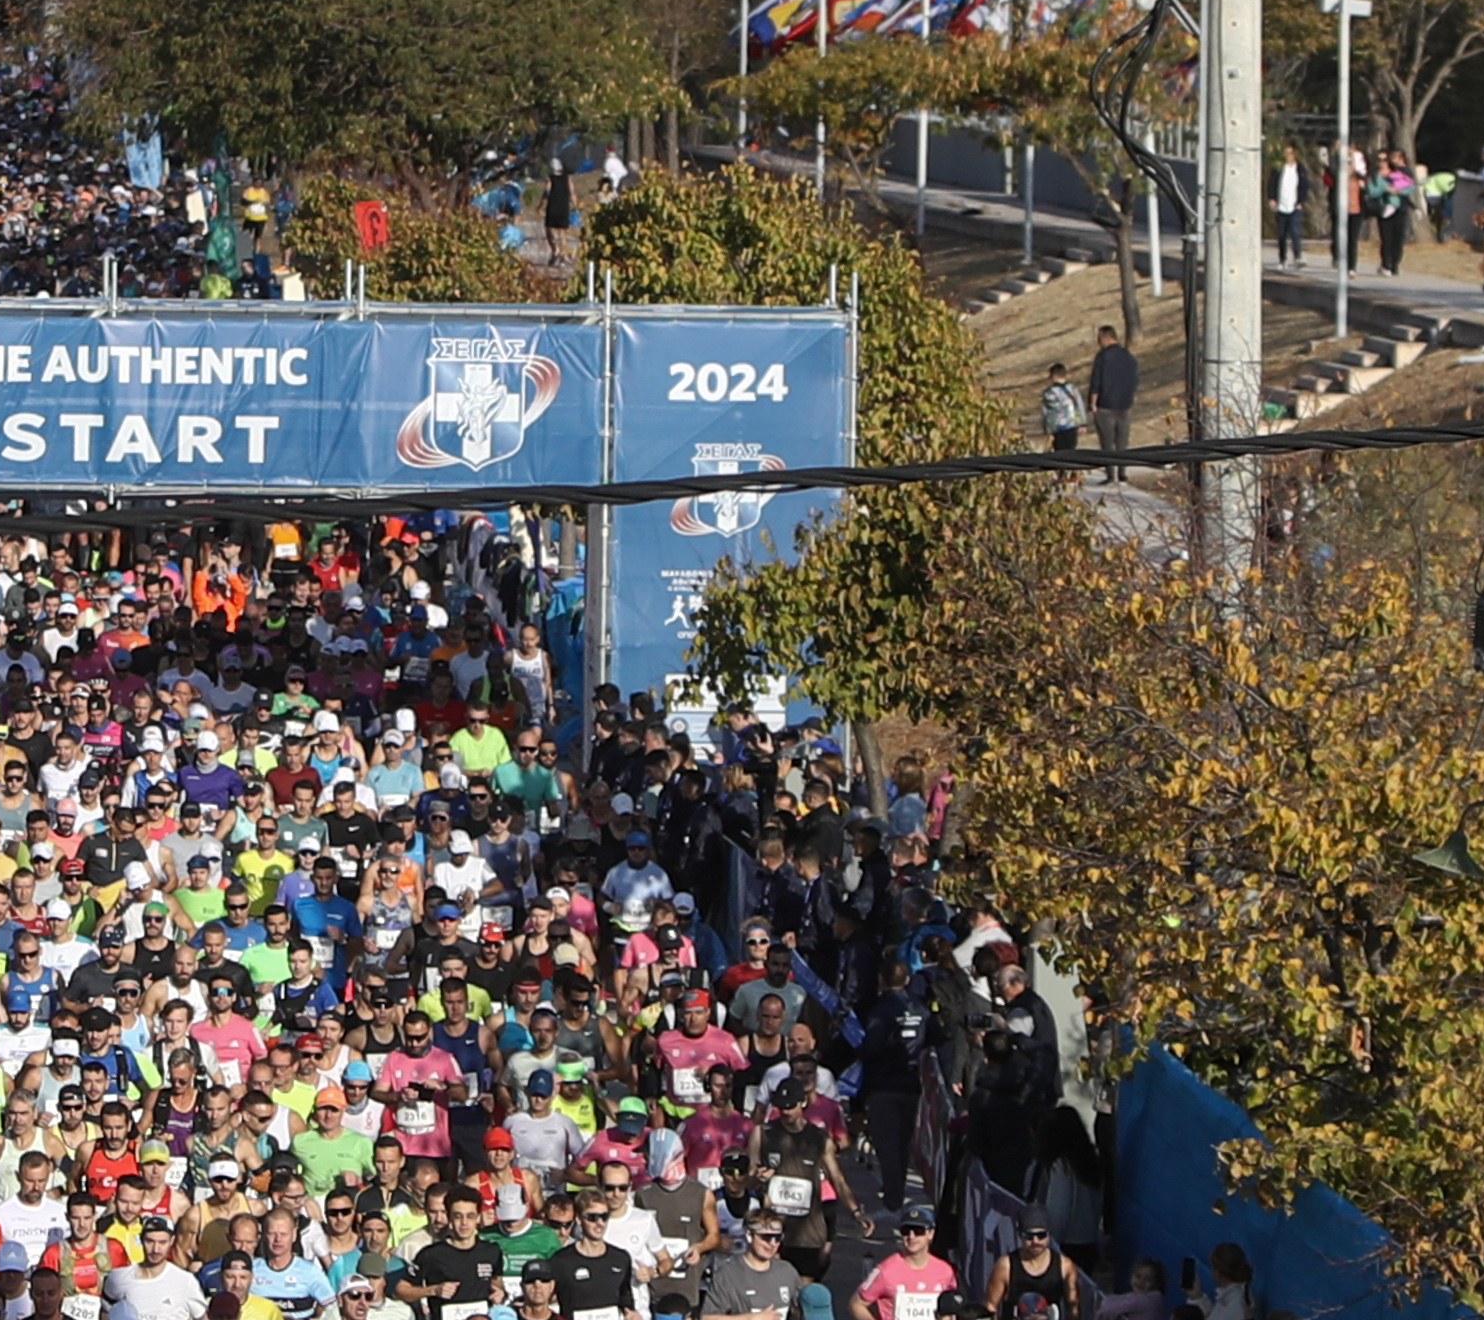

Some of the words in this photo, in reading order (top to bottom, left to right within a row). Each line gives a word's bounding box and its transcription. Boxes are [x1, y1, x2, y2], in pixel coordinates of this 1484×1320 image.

[431, 338, 526, 360] ΣΕΓΑΣ
[43, 347, 308, 386] AUTHENTIC
[668, 363, 789, 402] 2024
[694, 443, 762, 458] ΣΕΓΑΣ
